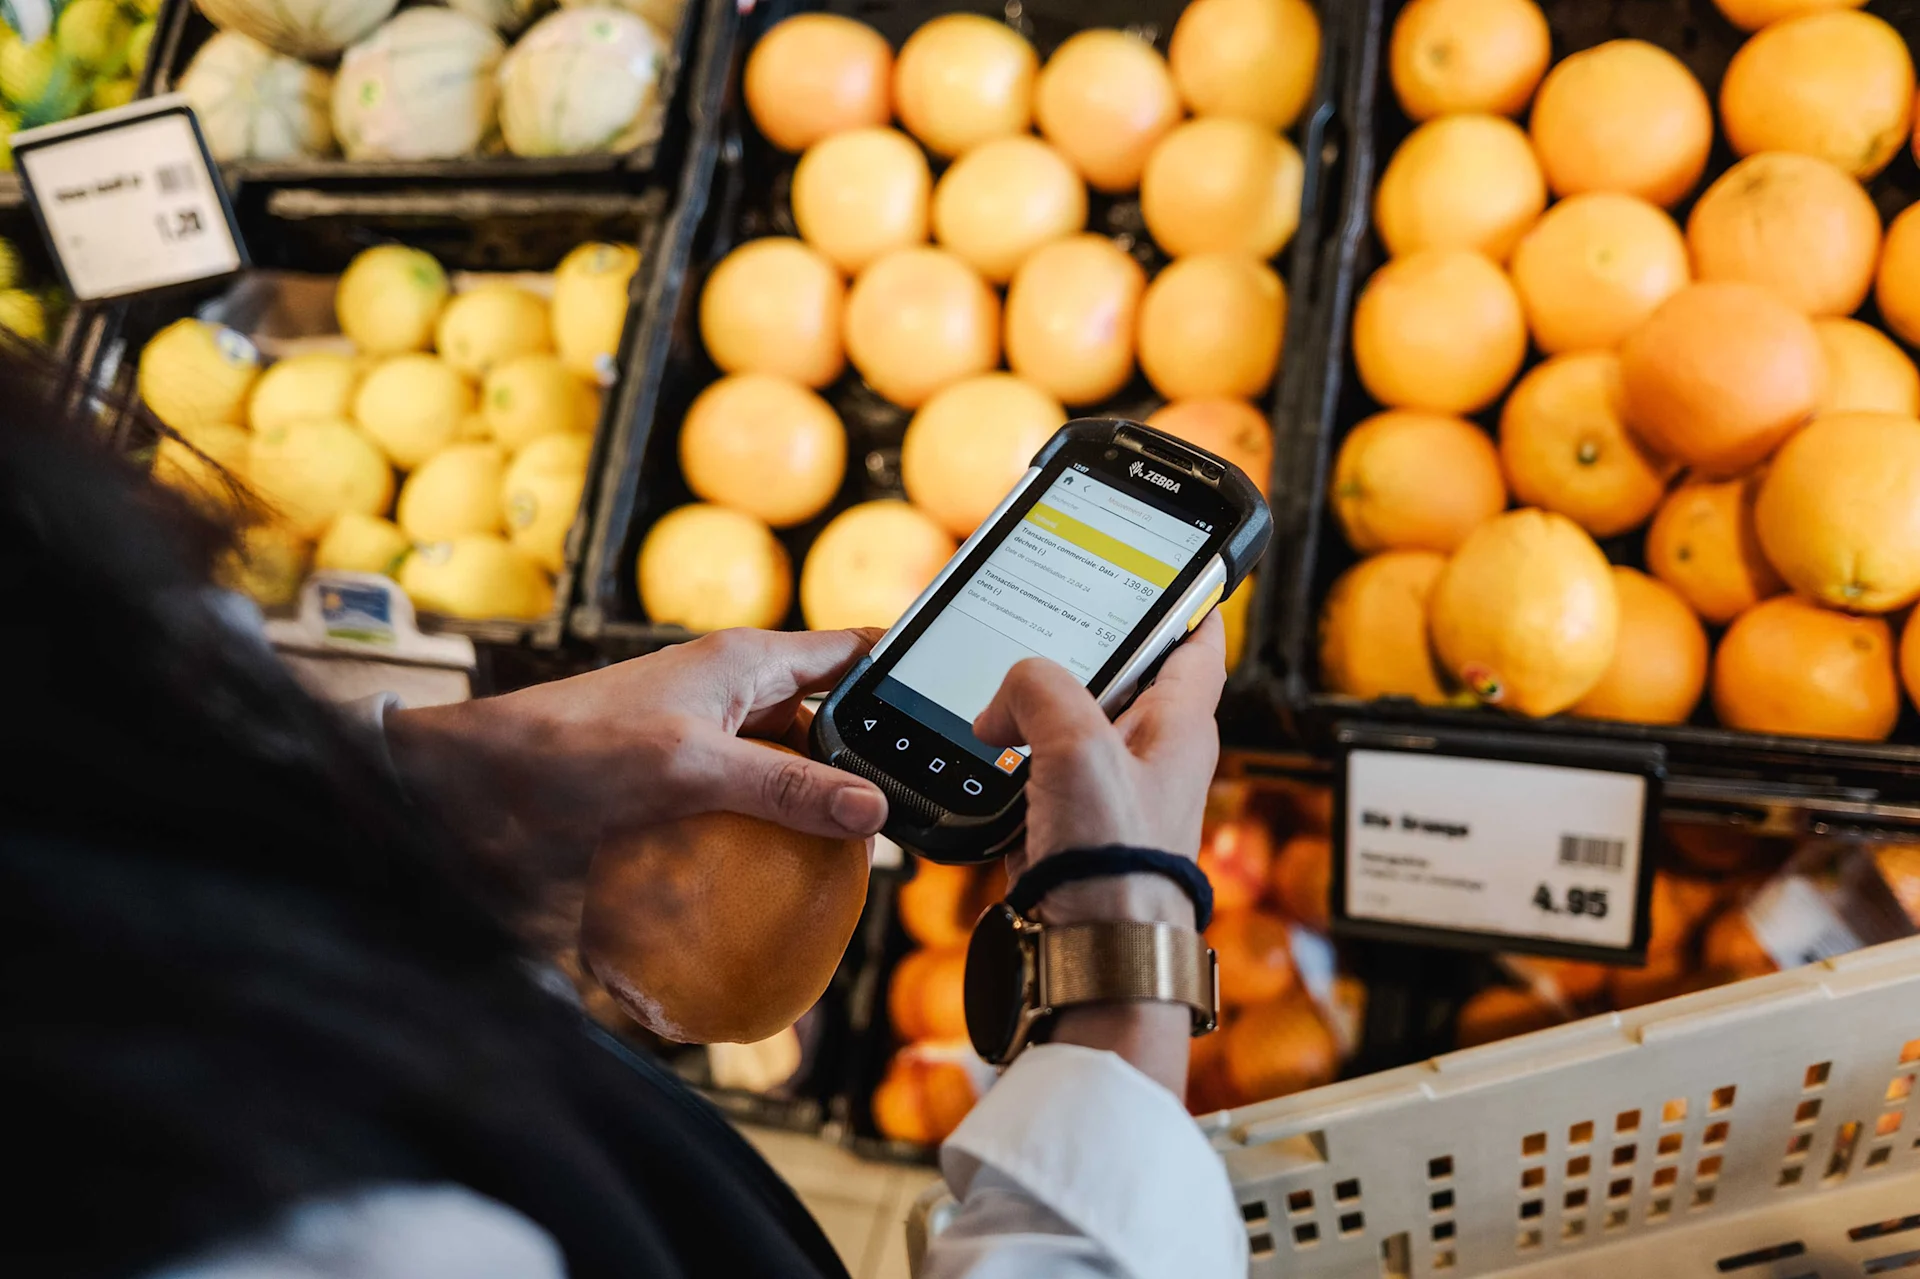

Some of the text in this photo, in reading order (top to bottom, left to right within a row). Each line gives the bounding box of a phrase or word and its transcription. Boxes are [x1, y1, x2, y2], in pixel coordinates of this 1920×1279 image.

[1073, 463, 1089, 473] 12:07
[1143, 470, 1181, 493] ZEBRA
[1108, 497, 1152, 522] Mouvement (2)
[1014, 535, 1038, 552] déchets
[1022, 527, 1057, 549] Transaction
[1056, 544, 1098, 569] commerciale:
[1098, 565, 1114, 577] Data
[1005, 546, 1016, 556] Date
[1024, 555, 1067, 582] comptabilisation:
[1067, 577, 1091, 593] 22.04.24
[976, 578, 994, 592] chets
[984, 569, 1020, 592] Transaction
[1019, 588, 1062, 614] commerciale:
[1061, 610, 1077, 623] Data
[1123, 578, 1154, 597] 139.80
[968, 589, 979, 599] Date
[987, 599, 1030, 627] comptabilisation:
[1029, 622, 1053, 638] 22.04.24
[1095, 627, 1117, 643] 5.50
[1532, 881, 1609, 920] 4.95
